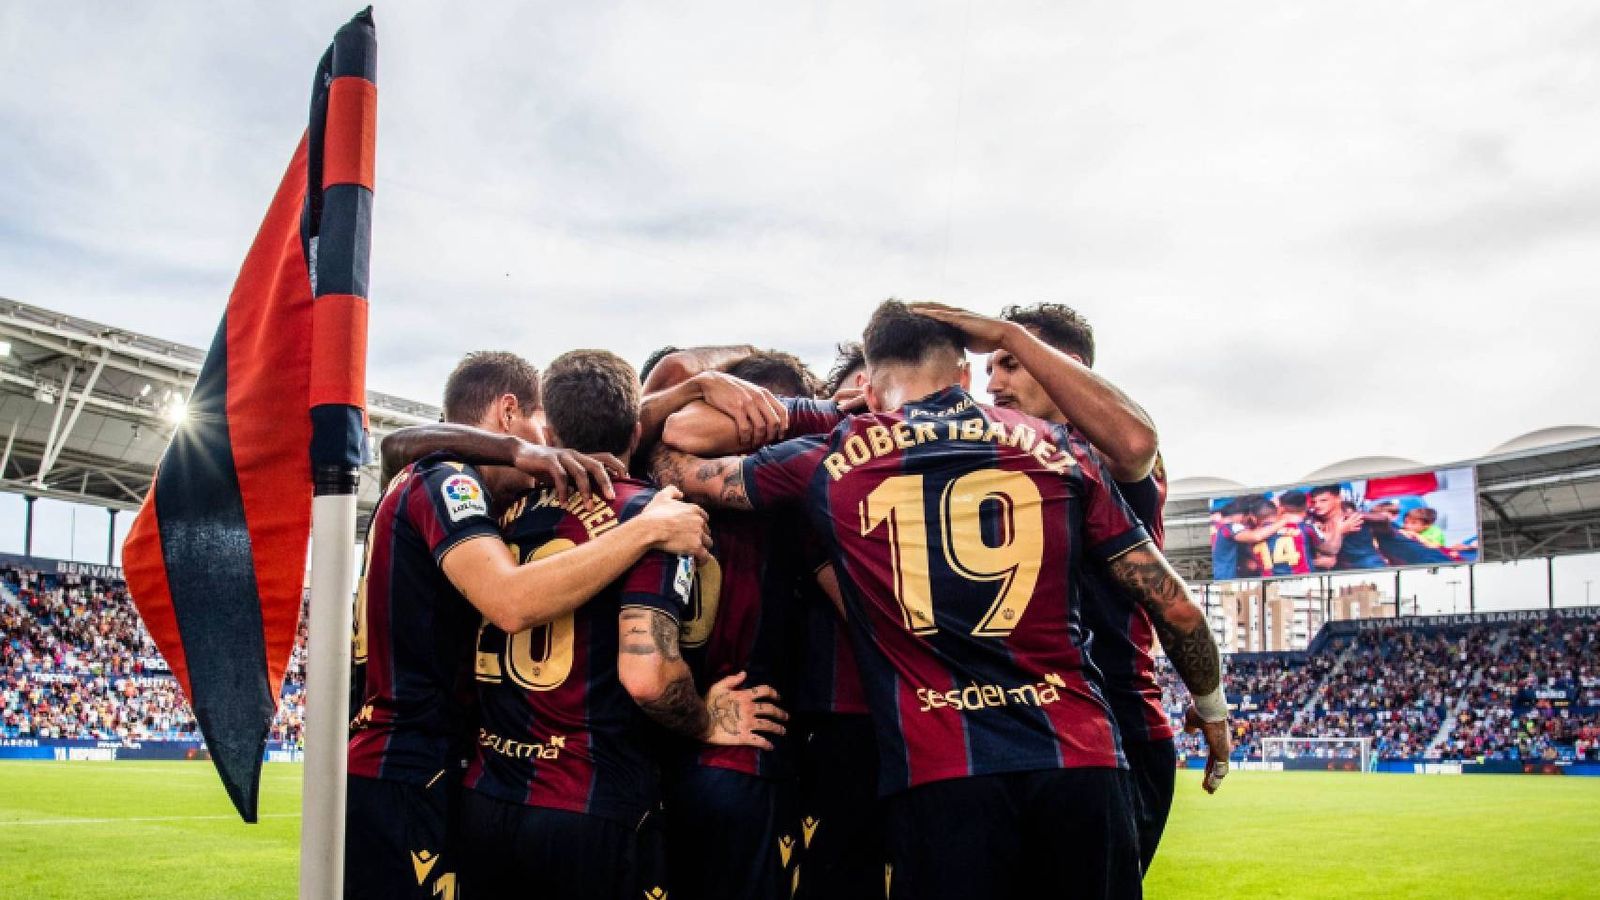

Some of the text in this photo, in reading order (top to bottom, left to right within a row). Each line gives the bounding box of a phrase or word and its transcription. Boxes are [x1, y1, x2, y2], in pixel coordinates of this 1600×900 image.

[822, 420, 938, 482] ROBER
[858, 468, 1044, 637] 19
[1253, 534, 1302, 570] 14
